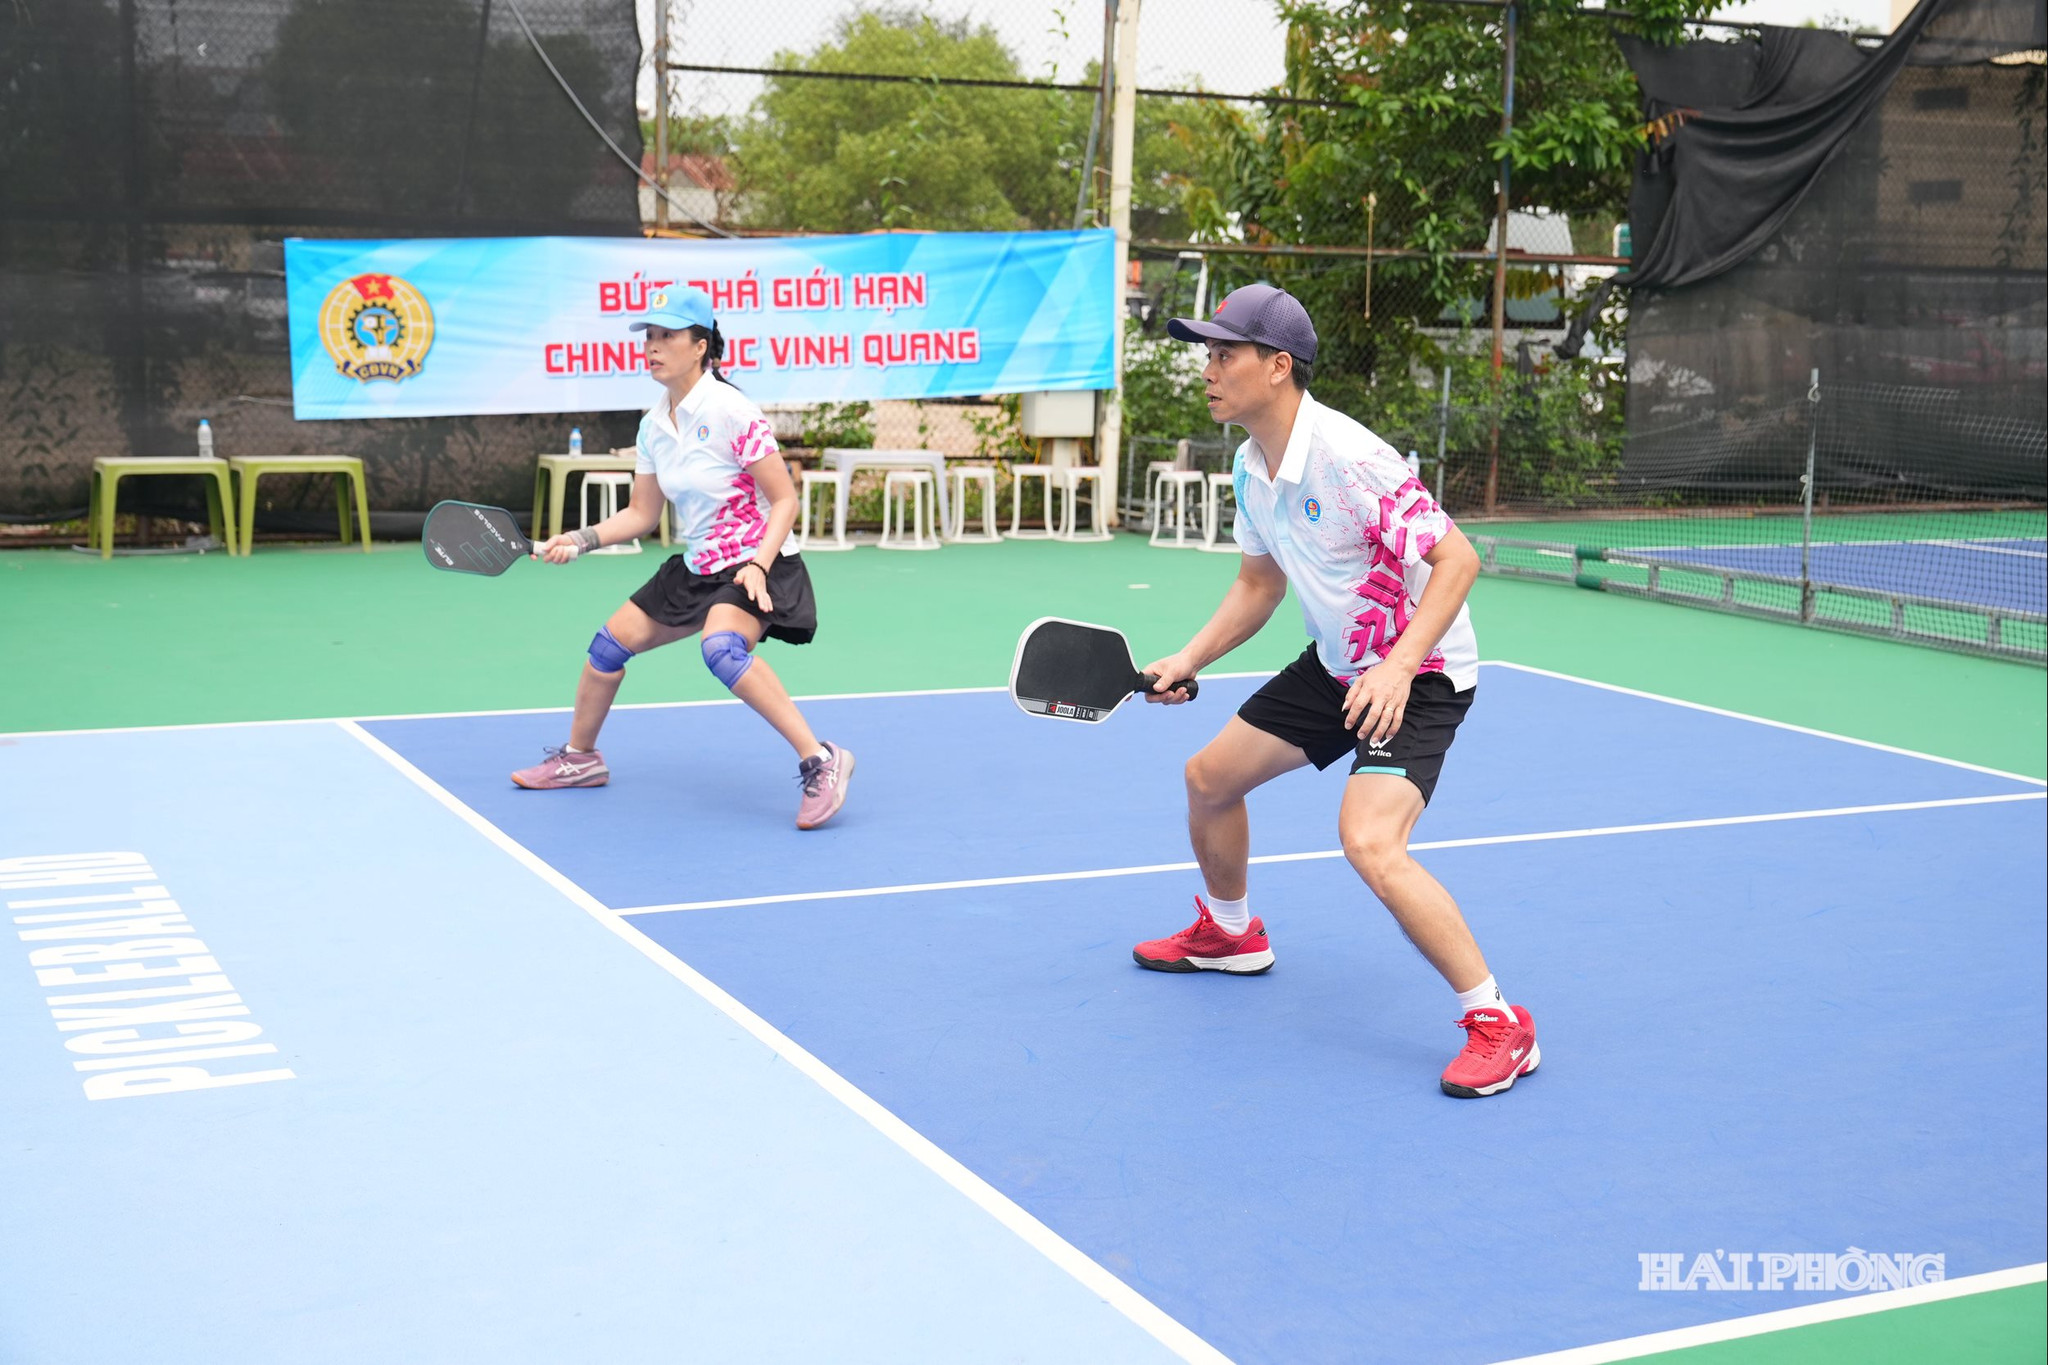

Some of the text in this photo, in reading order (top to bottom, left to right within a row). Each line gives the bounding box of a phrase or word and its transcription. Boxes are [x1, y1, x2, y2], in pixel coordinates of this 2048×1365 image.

[773, 268, 840, 307] GIỚI
[854, 275, 923, 313] HẠN
[545, 342, 650, 373] CHINH
[770, 335, 849, 366] VINH
[864, 331, 976, 366] QUANG
[1057, 705, 1074, 715] JOOLA
[7, 885, 297, 1100] PICKLEBALL
